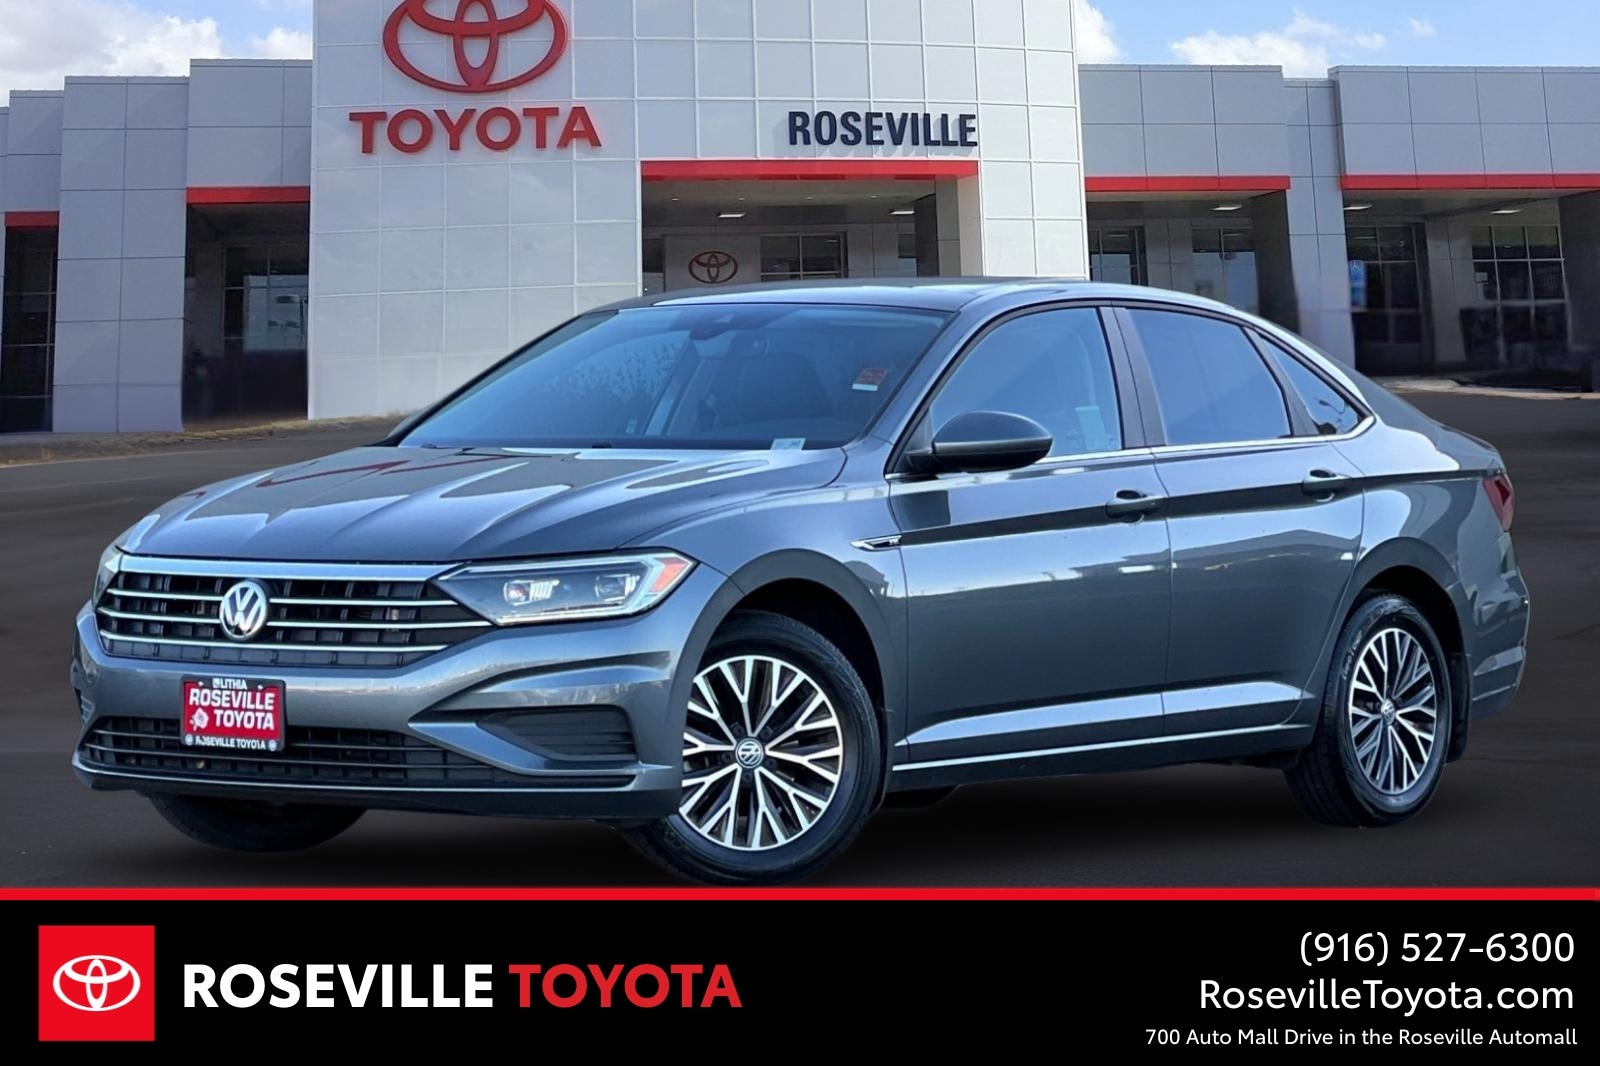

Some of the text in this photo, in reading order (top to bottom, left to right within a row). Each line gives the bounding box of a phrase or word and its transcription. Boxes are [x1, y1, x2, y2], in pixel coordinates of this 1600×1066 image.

[349, 106, 602, 155] TOYOTA
[788, 110, 979, 148] ROSEVILLE
[220, 678, 247, 690] LITHIA
[189, 688, 275, 711] ROSEVILLE
[213, 709, 275, 731] TOYOTA
